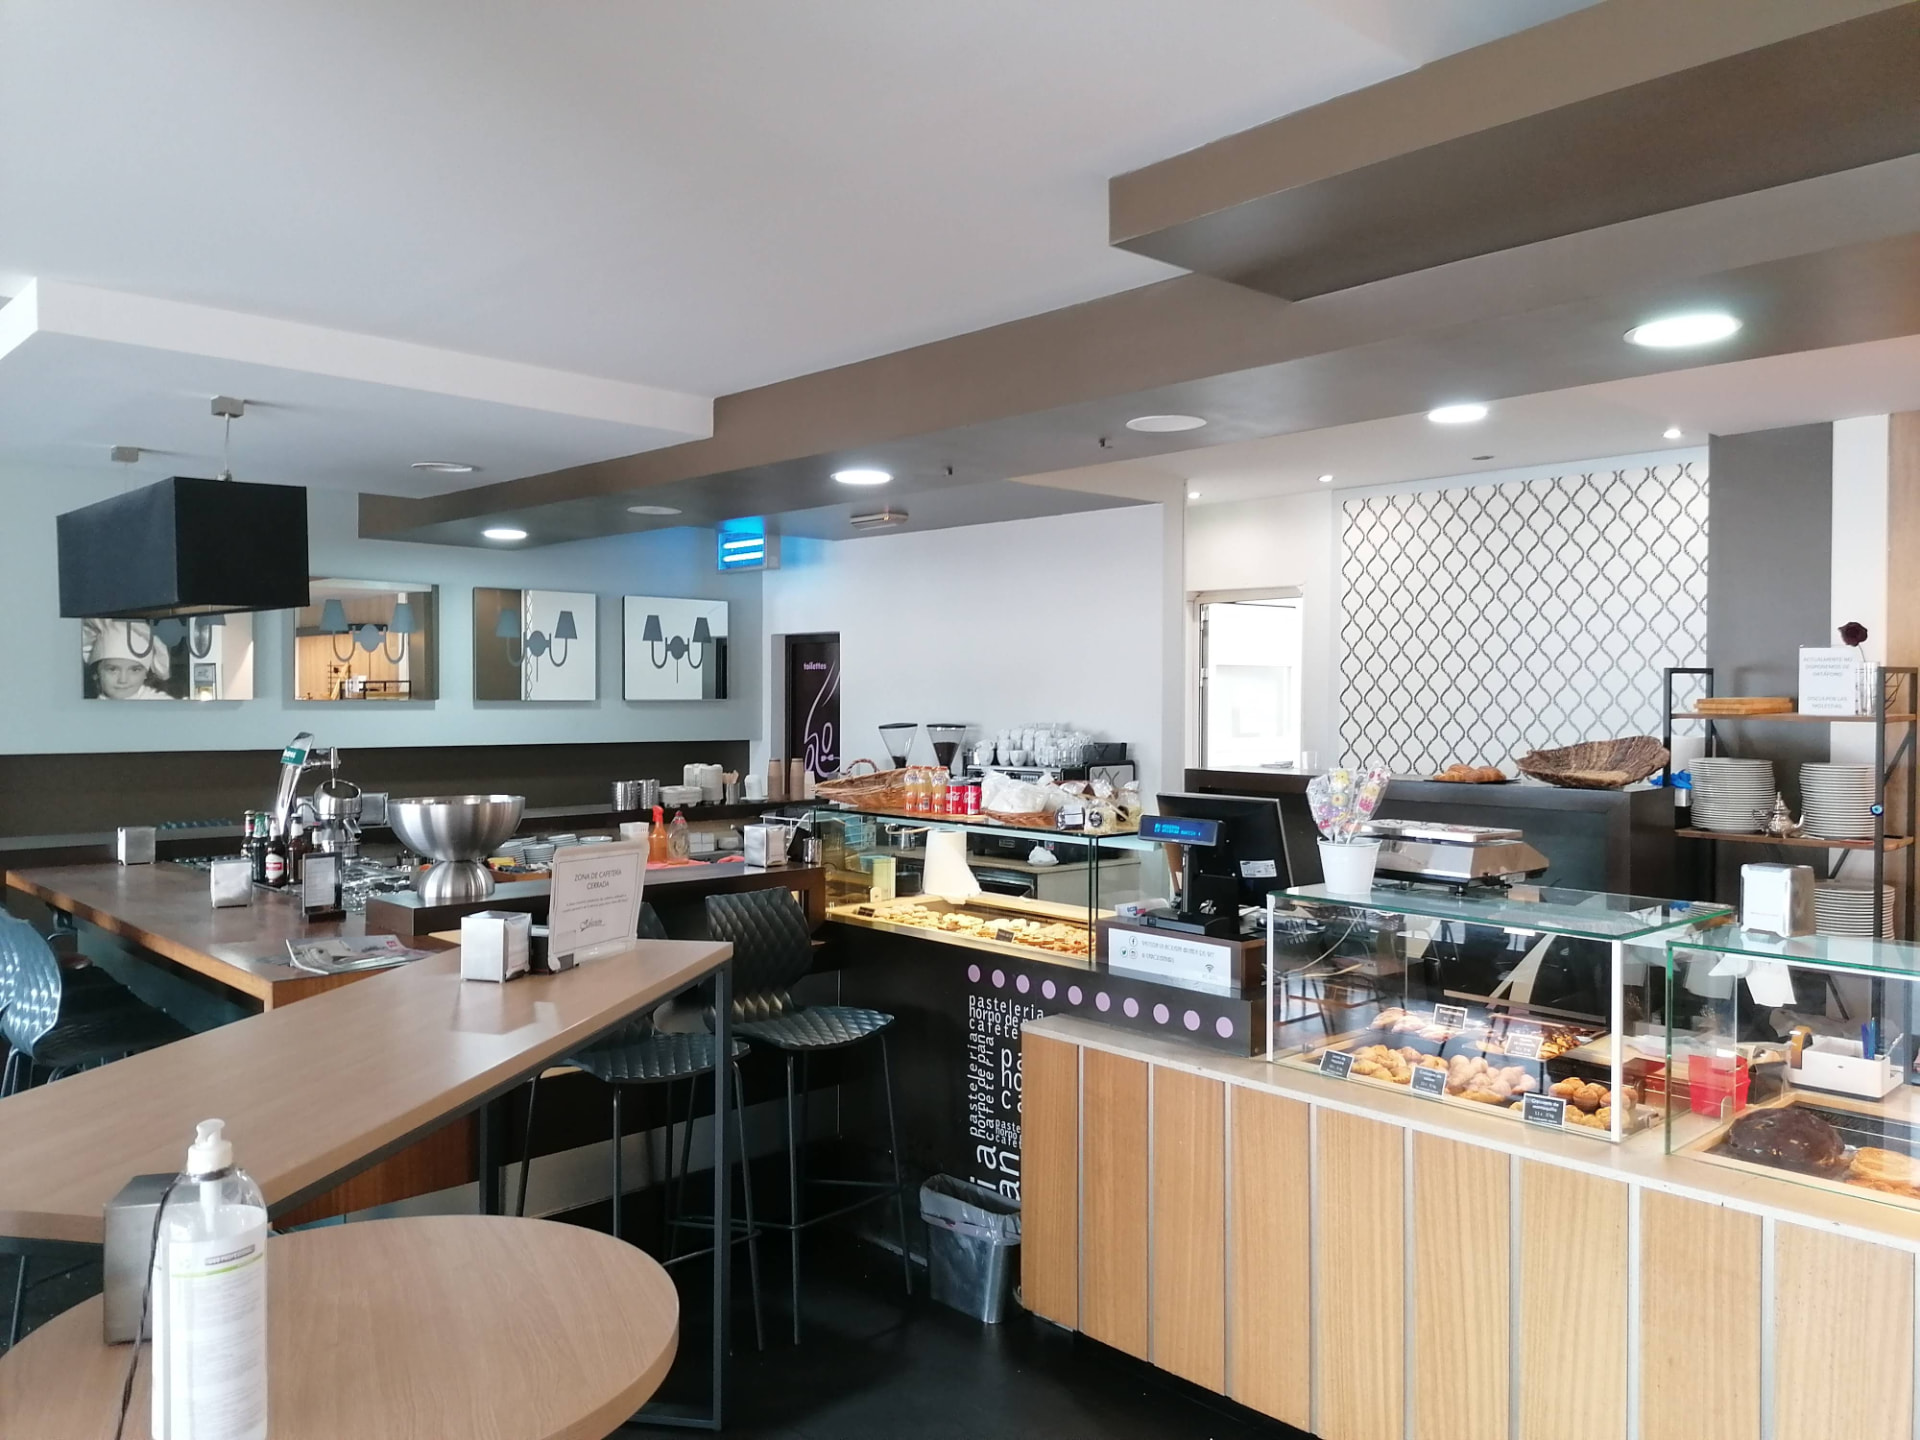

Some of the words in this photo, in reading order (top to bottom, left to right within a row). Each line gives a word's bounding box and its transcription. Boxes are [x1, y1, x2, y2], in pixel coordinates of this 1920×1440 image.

[574, 873, 590, 882] ZONA
[586, 881, 610, 890] CERRADA
[969, 994, 1044, 1021] pasteleria
[969, 1018, 1018, 1040] cafete
[995, 1119, 1021, 1133] paste
